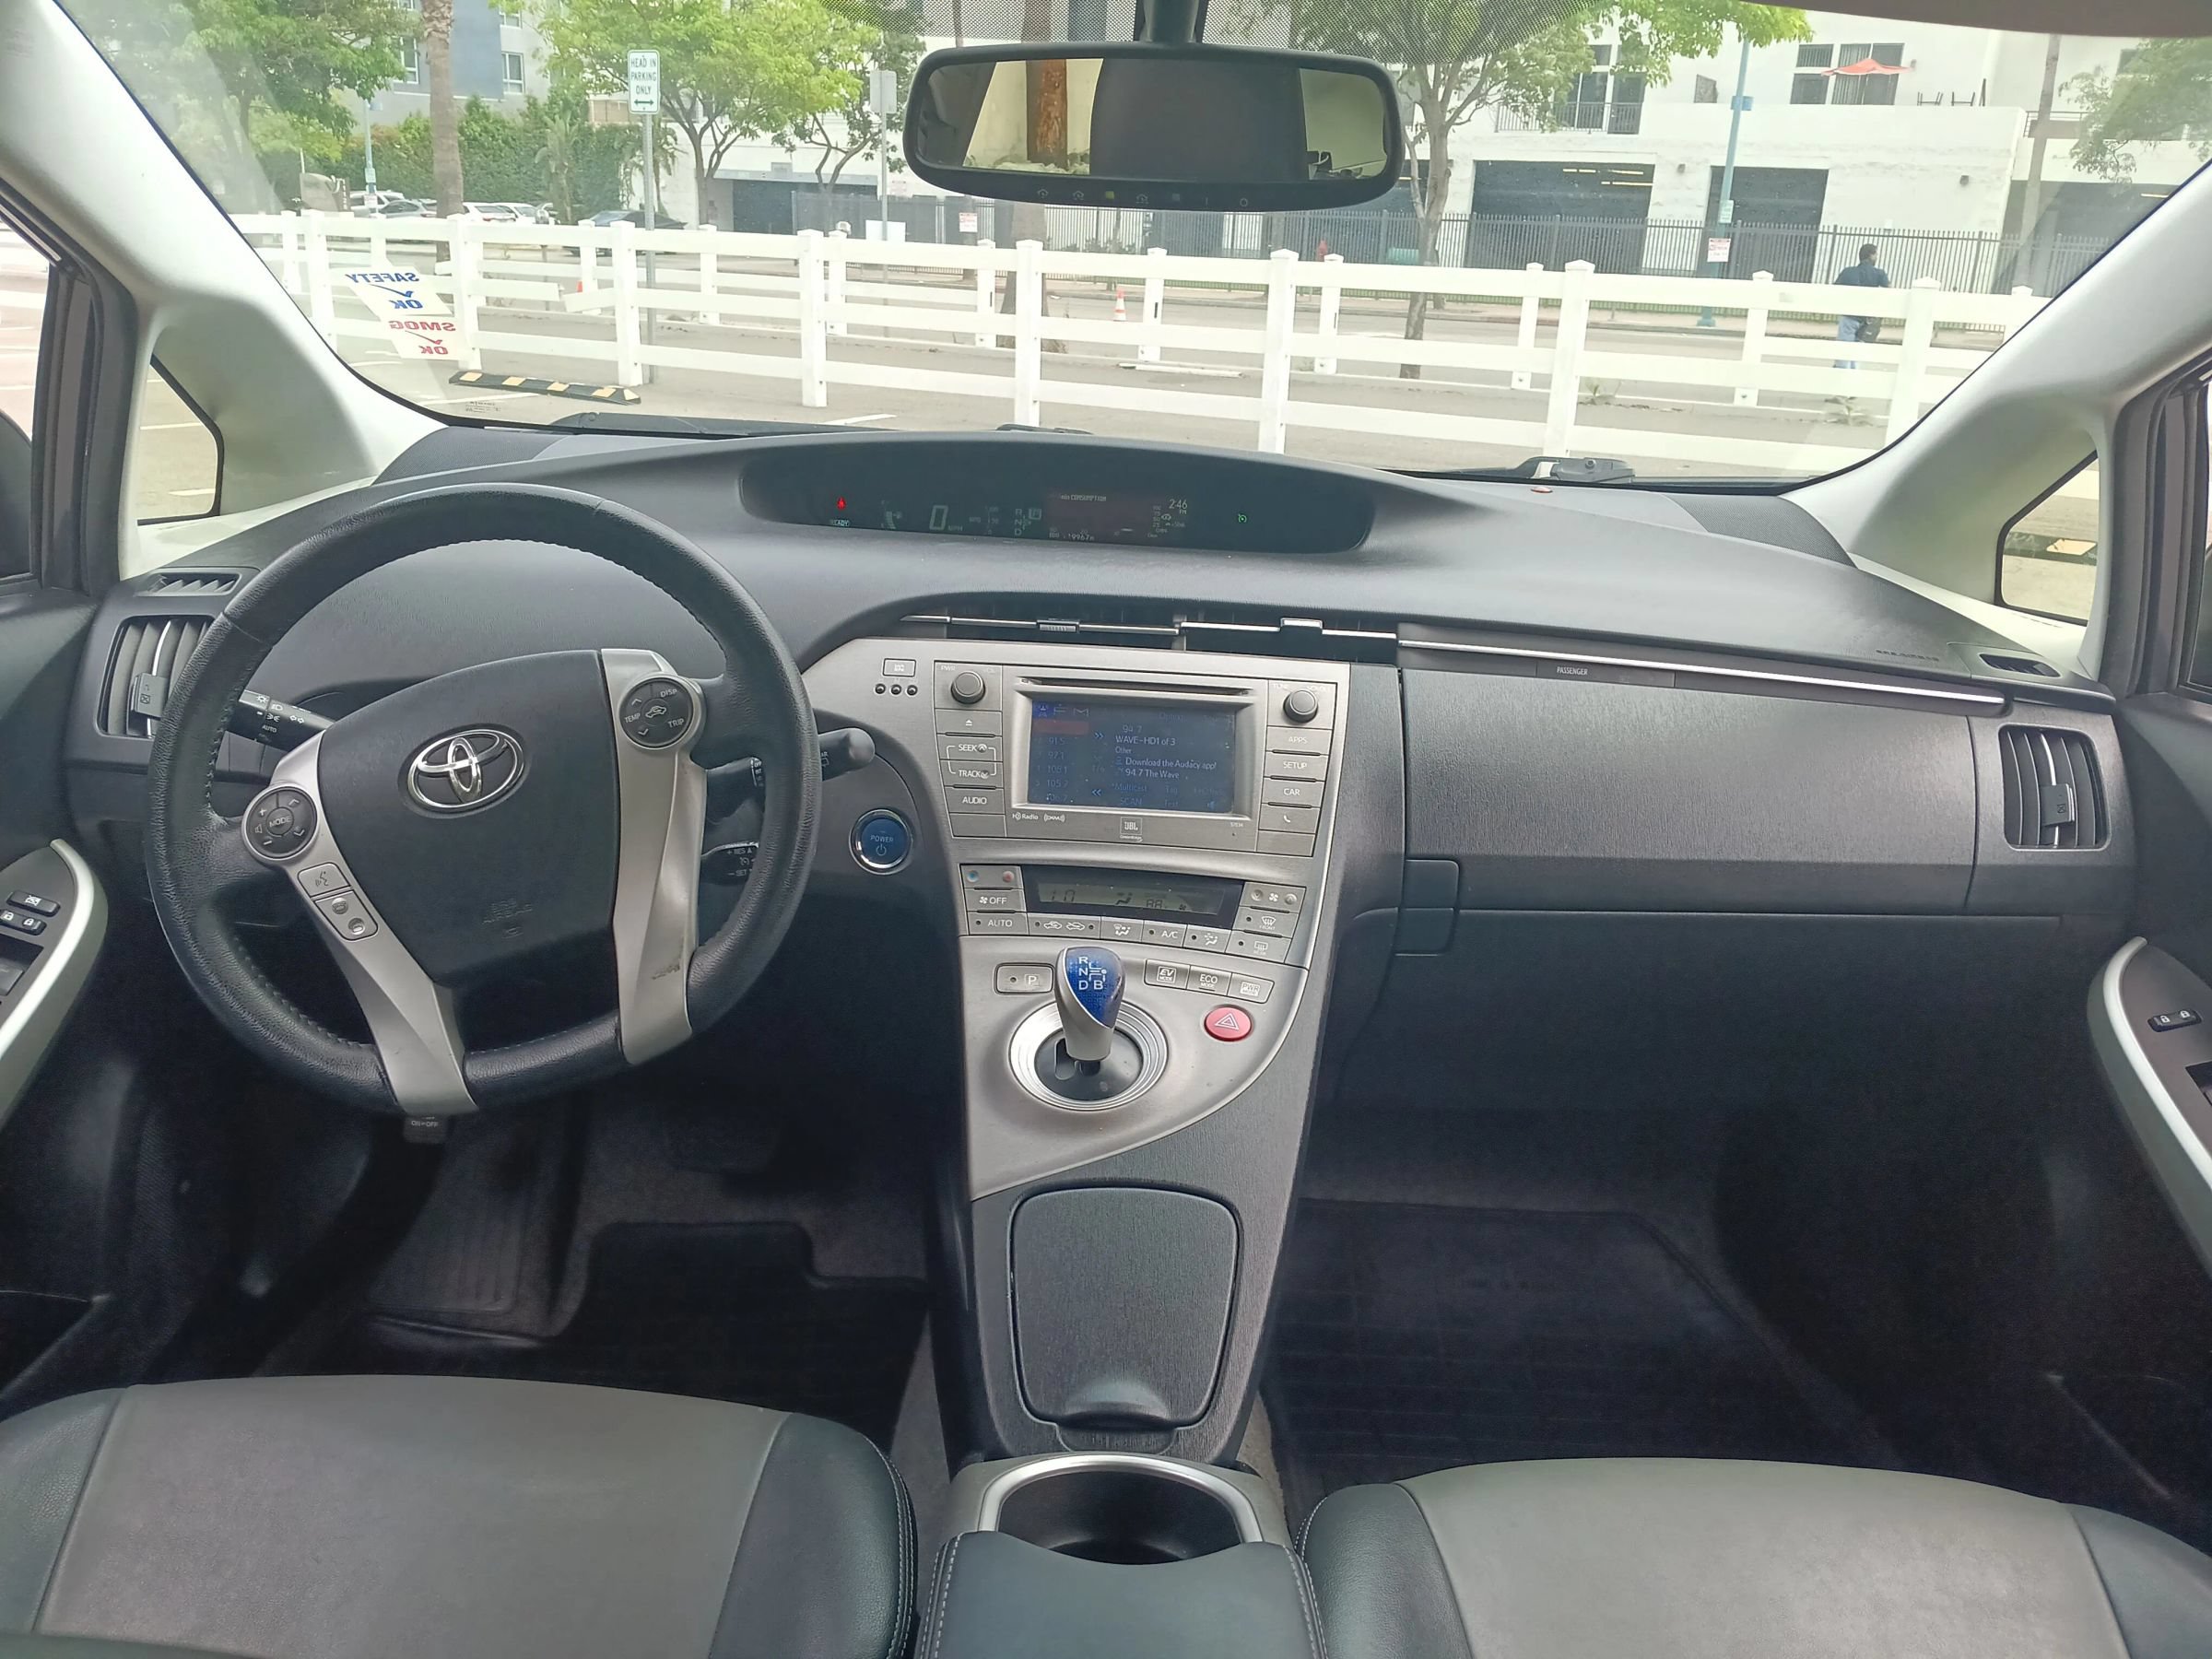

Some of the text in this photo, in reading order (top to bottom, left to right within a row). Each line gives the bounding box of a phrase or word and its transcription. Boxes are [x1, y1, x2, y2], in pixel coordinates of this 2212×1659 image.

[630, 57, 656, 67] HEAD IN
[630, 71, 656, 81] PARKING
[635, 85, 652, 95] ONLY
[1169, 499, 1188, 510] 2:46
[1556, 665, 1588, 676] PASSENGER
[660, 688, 677, 698] DISP
[624, 712, 641, 724] TEMP
[667, 718, 685, 728] TRIP
[1171, 738, 1177, 747] 3
[1288, 735, 1308, 744] APPS
[958, 743, 977, 752] SEEK
[1124, 757, 1161, 767] Download
[1161, 759, 1174, 768] the
[1174, 759, 1201, 771] Audacy
[1283, 760, 1308, 770] SETUP
[958, 768, 981, 778] TRACK
[1143, 769, 1159, 778] The
[1159, 770, 1181, 780] Wave
[1283, 788, 1300, 796] CAR
[962, 795, 987, 805] AUDIO
[269, 817, 291, 828] MODE
[1124, 820, 1138, 830] JBL
[870, 835, 894, 843] POWER
[989, 896, 1007, 904] OFF
[987, 919, 1013, 927] AUTO
[1161, 930, 1179, 939] A/C
[1078, 956, 1088, 964] R
[1078, 968, 1088, 976] N
[1159, 969, 1174, 977] EV
[1028, 975, 1037, 985] P
[1199, 973, 1218, 984] ECO
[1078, 979, 1103, 990] D B
